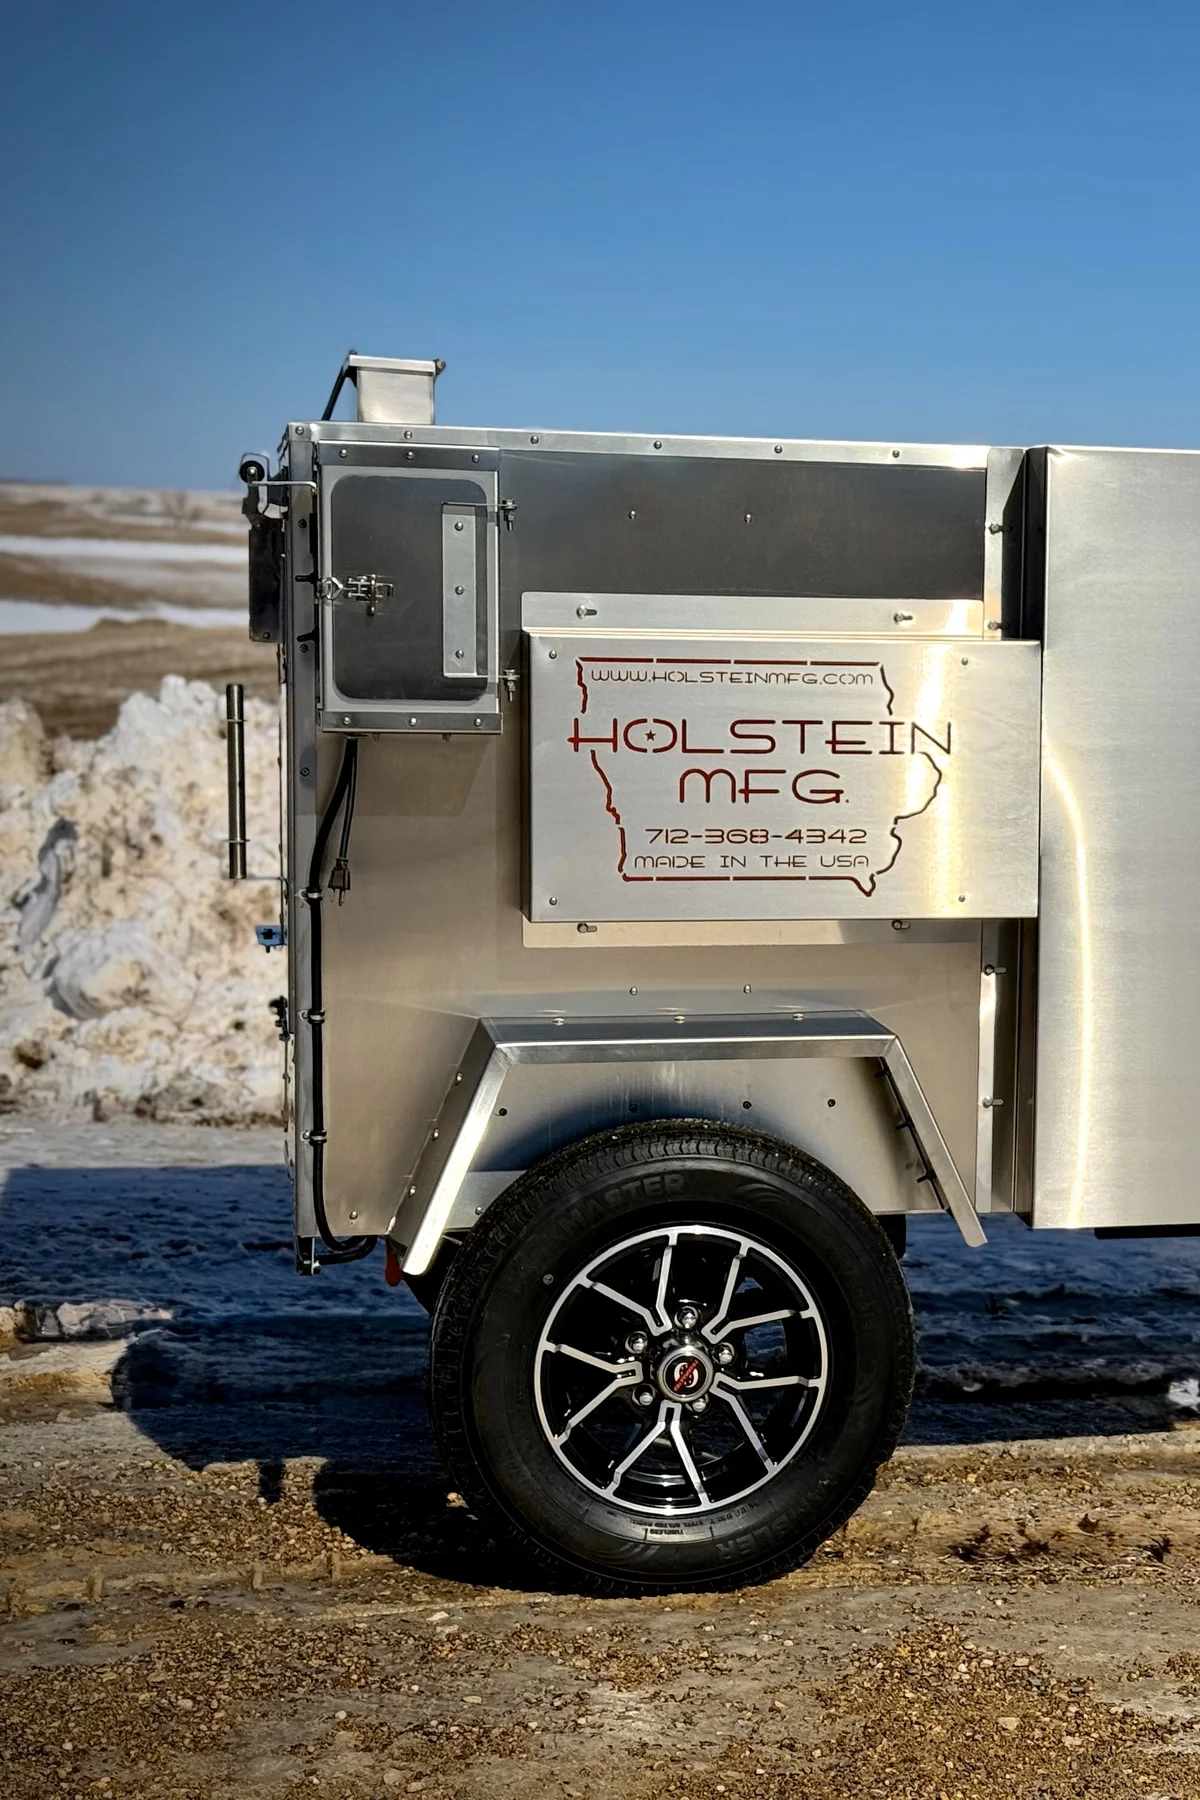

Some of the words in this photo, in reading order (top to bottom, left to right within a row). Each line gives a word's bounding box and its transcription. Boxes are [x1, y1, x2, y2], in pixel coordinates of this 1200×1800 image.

[567, 717, 952, 755] HOLSTEIN
[679, 768, 849, 804] MFG.
[645, 828, 867, 844] 712-368-4342
[634, 855, 706, 868] MADE
[720, 855, 747, 868] IN
[760, 855, 808, 868] THE
[820, 855, 869, 868] USA
